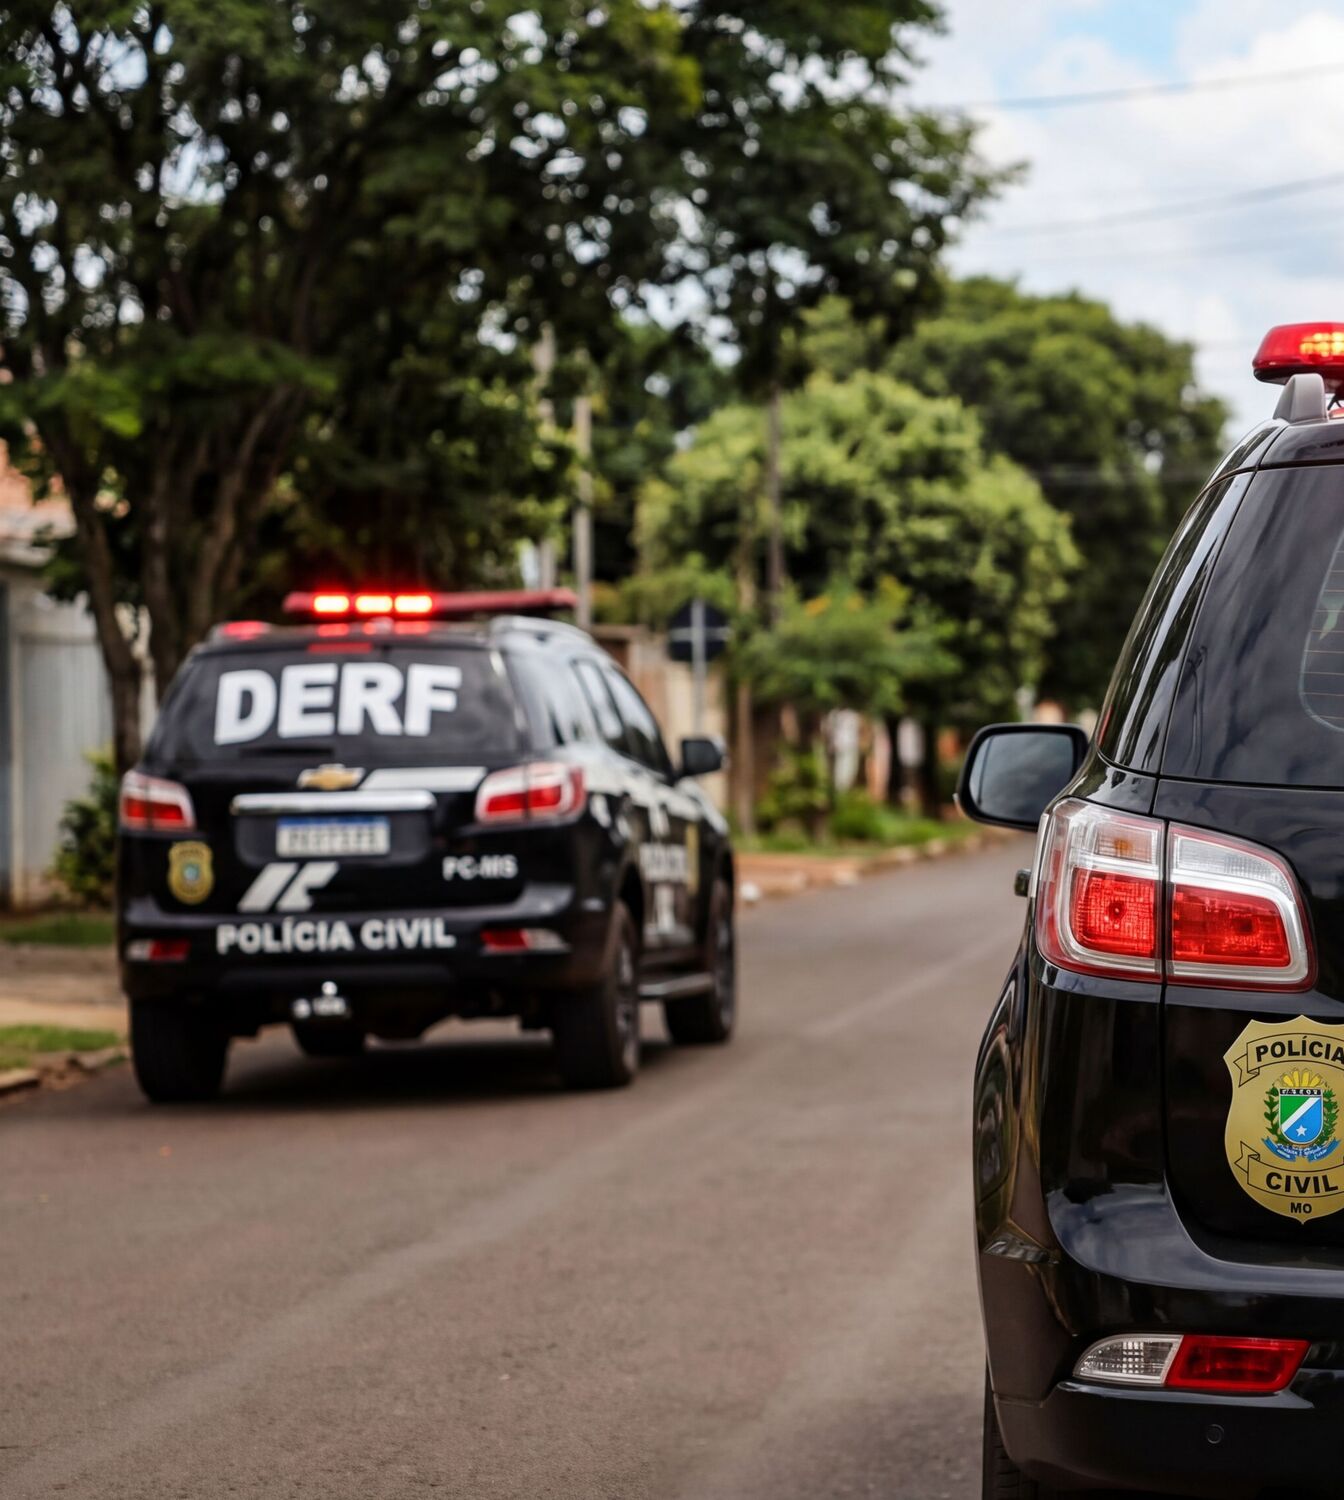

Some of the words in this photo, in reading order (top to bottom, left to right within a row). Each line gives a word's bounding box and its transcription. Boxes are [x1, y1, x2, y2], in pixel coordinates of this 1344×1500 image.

[214, 662, 462, 745] DERF
[217, 916, 354, 953] POLÍCIA
[360, 916, 456, 950] CIVIL
[1265, 1171, 1339, 1194] CIVIL
[1290, 1201, 1313, 1214] MO
